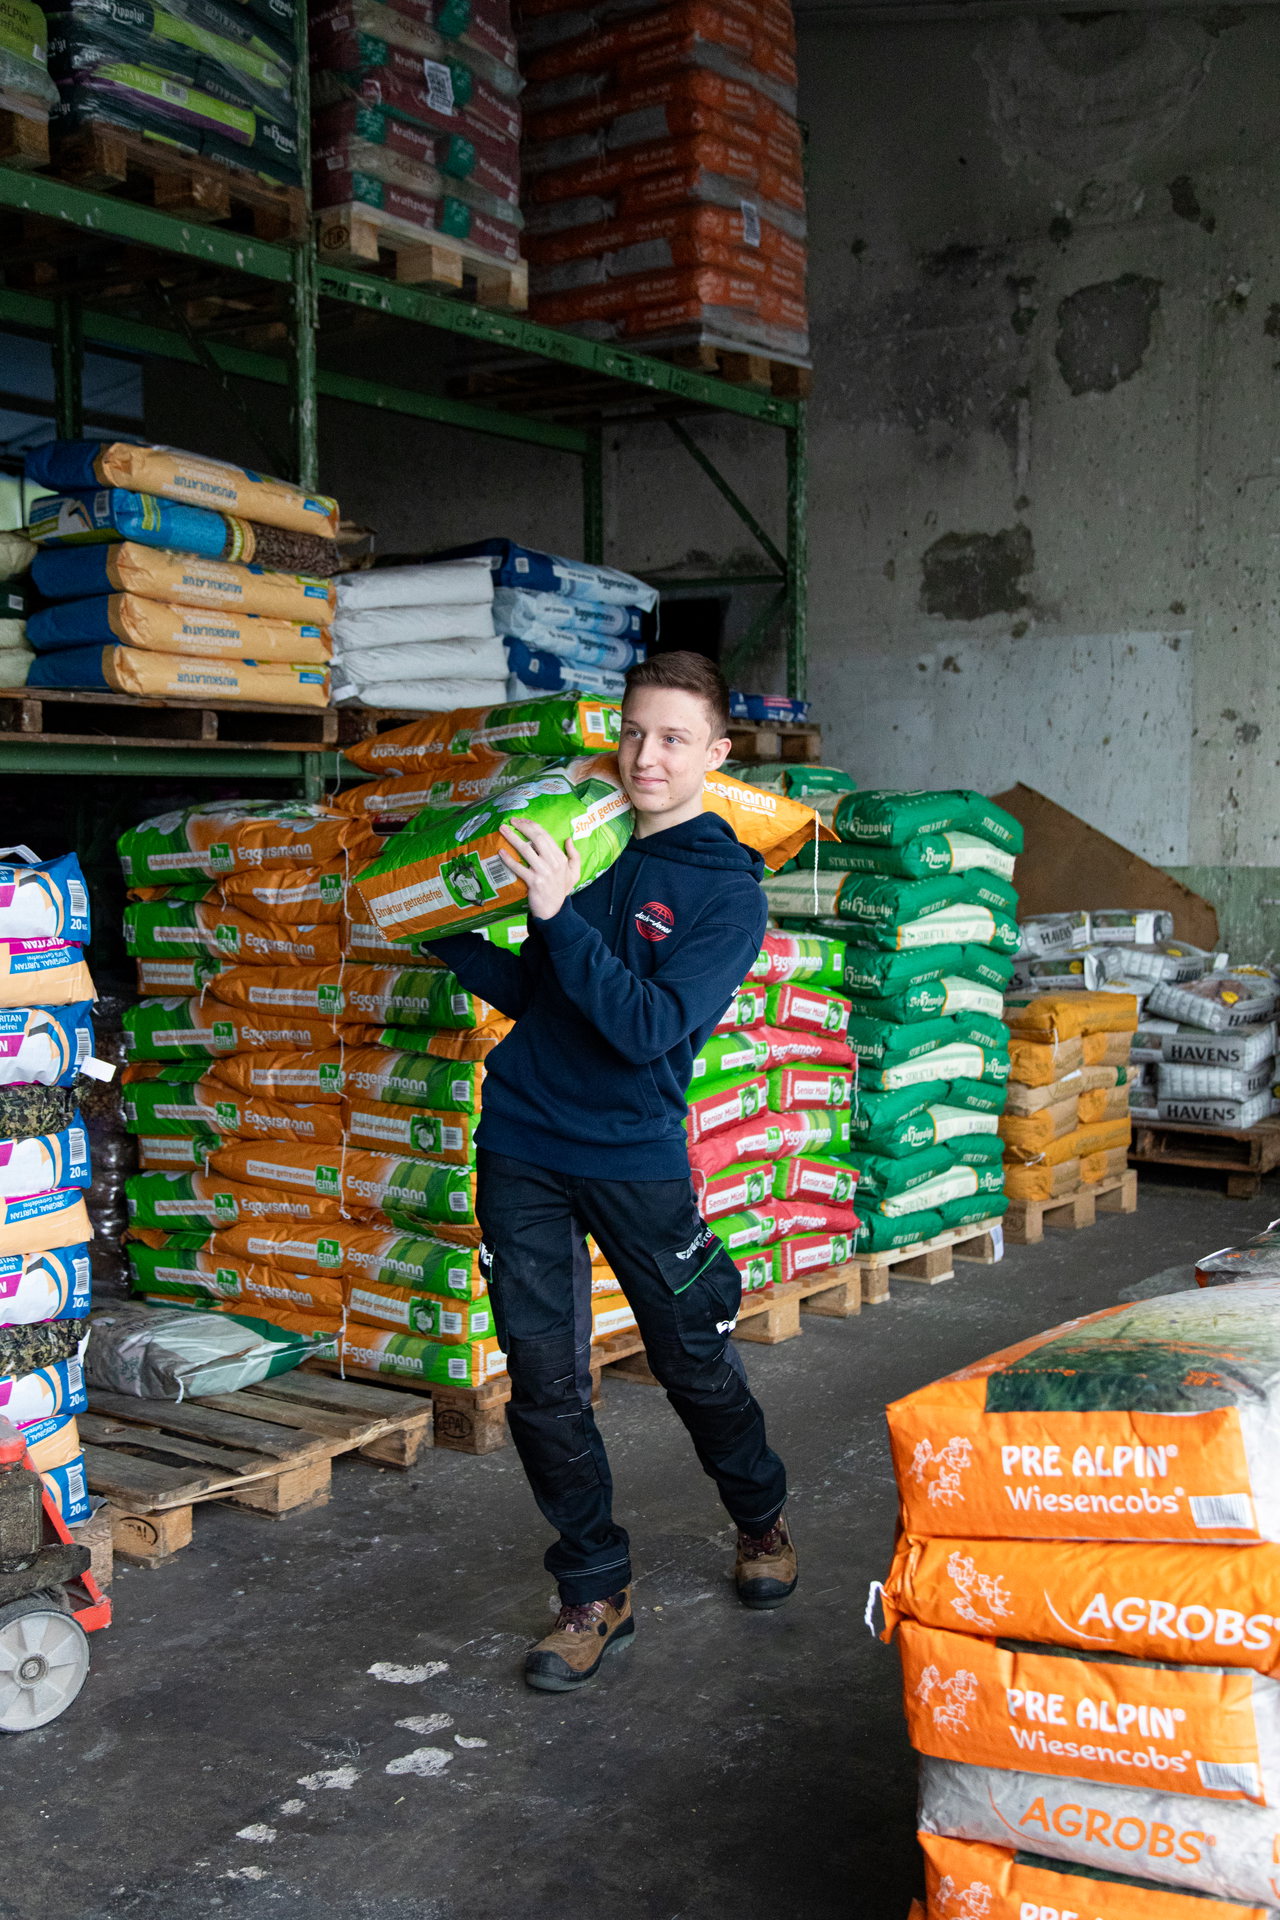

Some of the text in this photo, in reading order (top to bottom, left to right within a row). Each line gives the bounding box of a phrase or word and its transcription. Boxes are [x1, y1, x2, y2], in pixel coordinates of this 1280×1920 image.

[375, 887, 444, 919] Struktur getreidefrei
[70, 918, 82, 930] 20
[349, 990, 430, 1012] Eggersmann
[1171, 1045, 1240, 1062] HAVENS
[1167, 1105, 1236, 1121] HAVENS
[70, 1166, 80, 1179] 20
[346, 1175, 428, 1203] Eggersmann
[344, 1343, 423, 1370] Eggersmann
[70, 1393, 79, 1407] 20
[1001, 1446, 1062, 1476] PRE
[70, 1502, 81, 1516] 20
[1006, 1688, 1068, 1726] PRE
